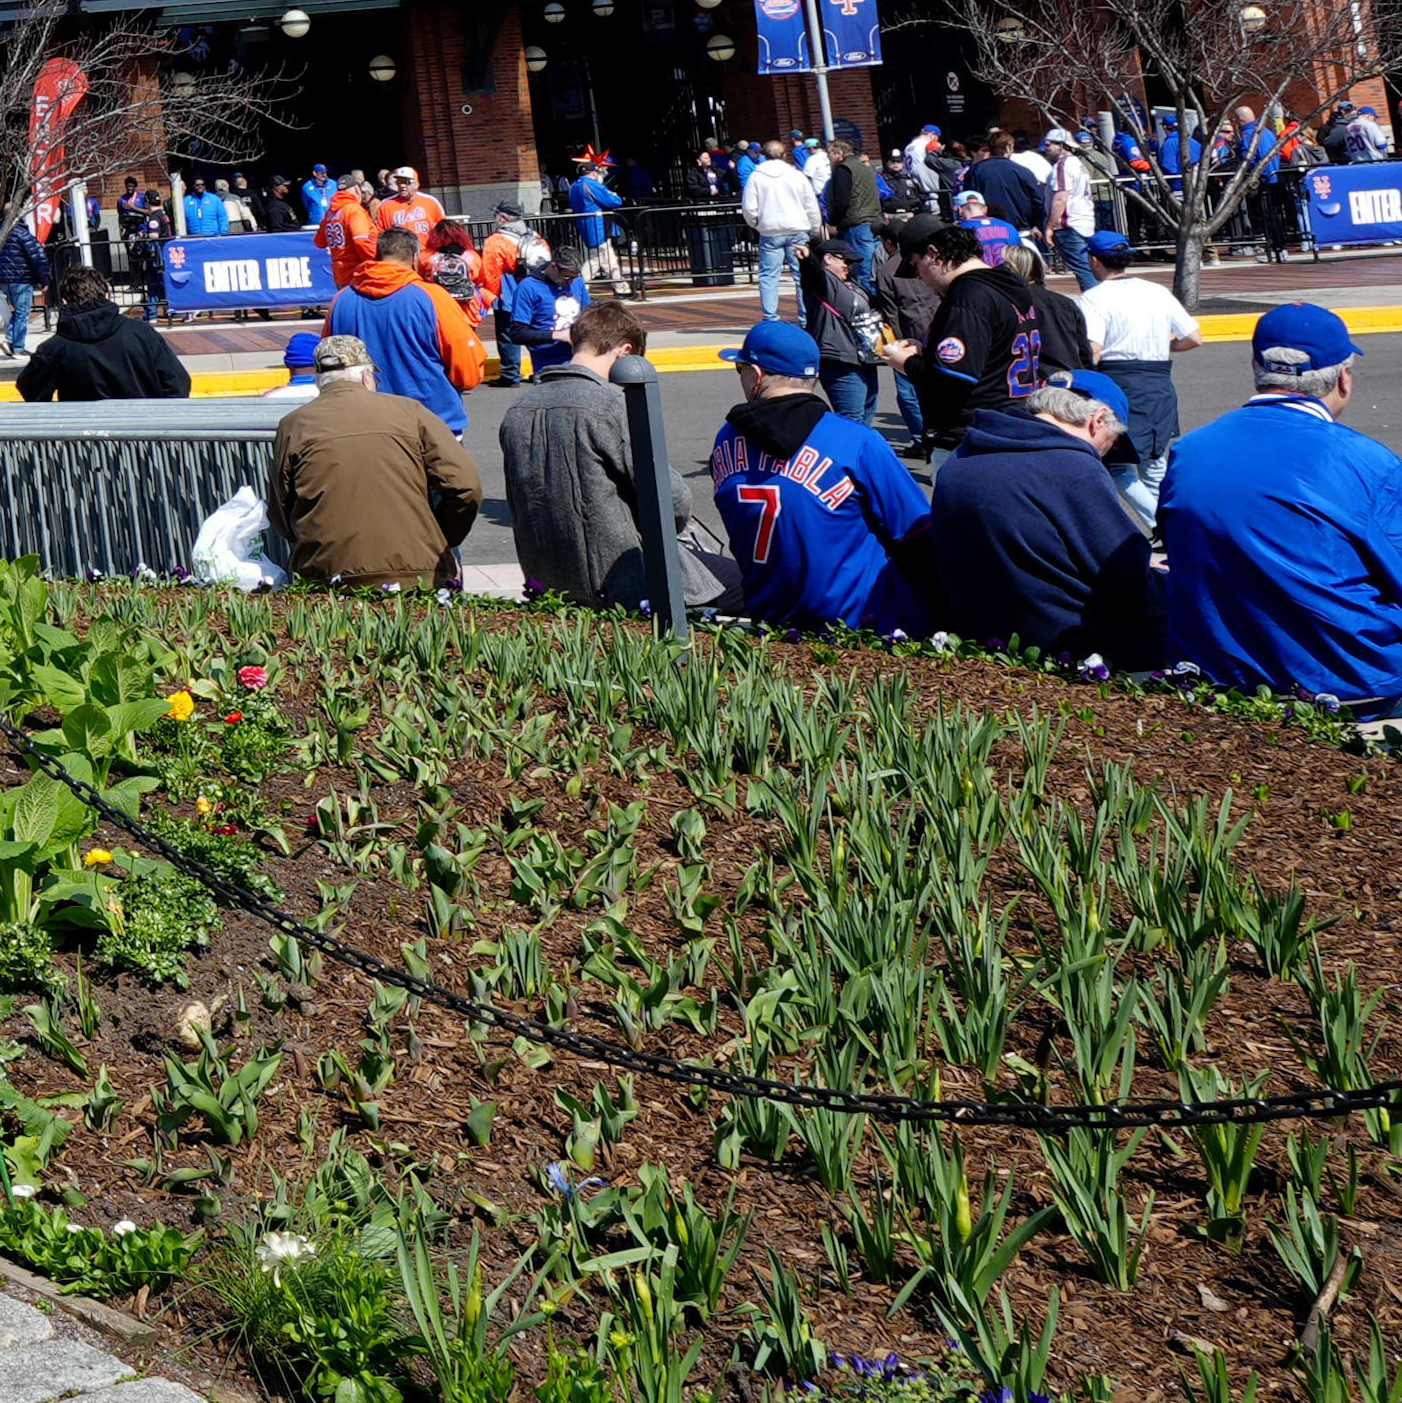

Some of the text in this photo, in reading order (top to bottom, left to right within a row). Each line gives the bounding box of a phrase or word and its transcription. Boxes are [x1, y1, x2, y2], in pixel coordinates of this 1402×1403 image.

[203, 257, 312, 293] ENTER HERE
[736, 484, 782, 564] 7
